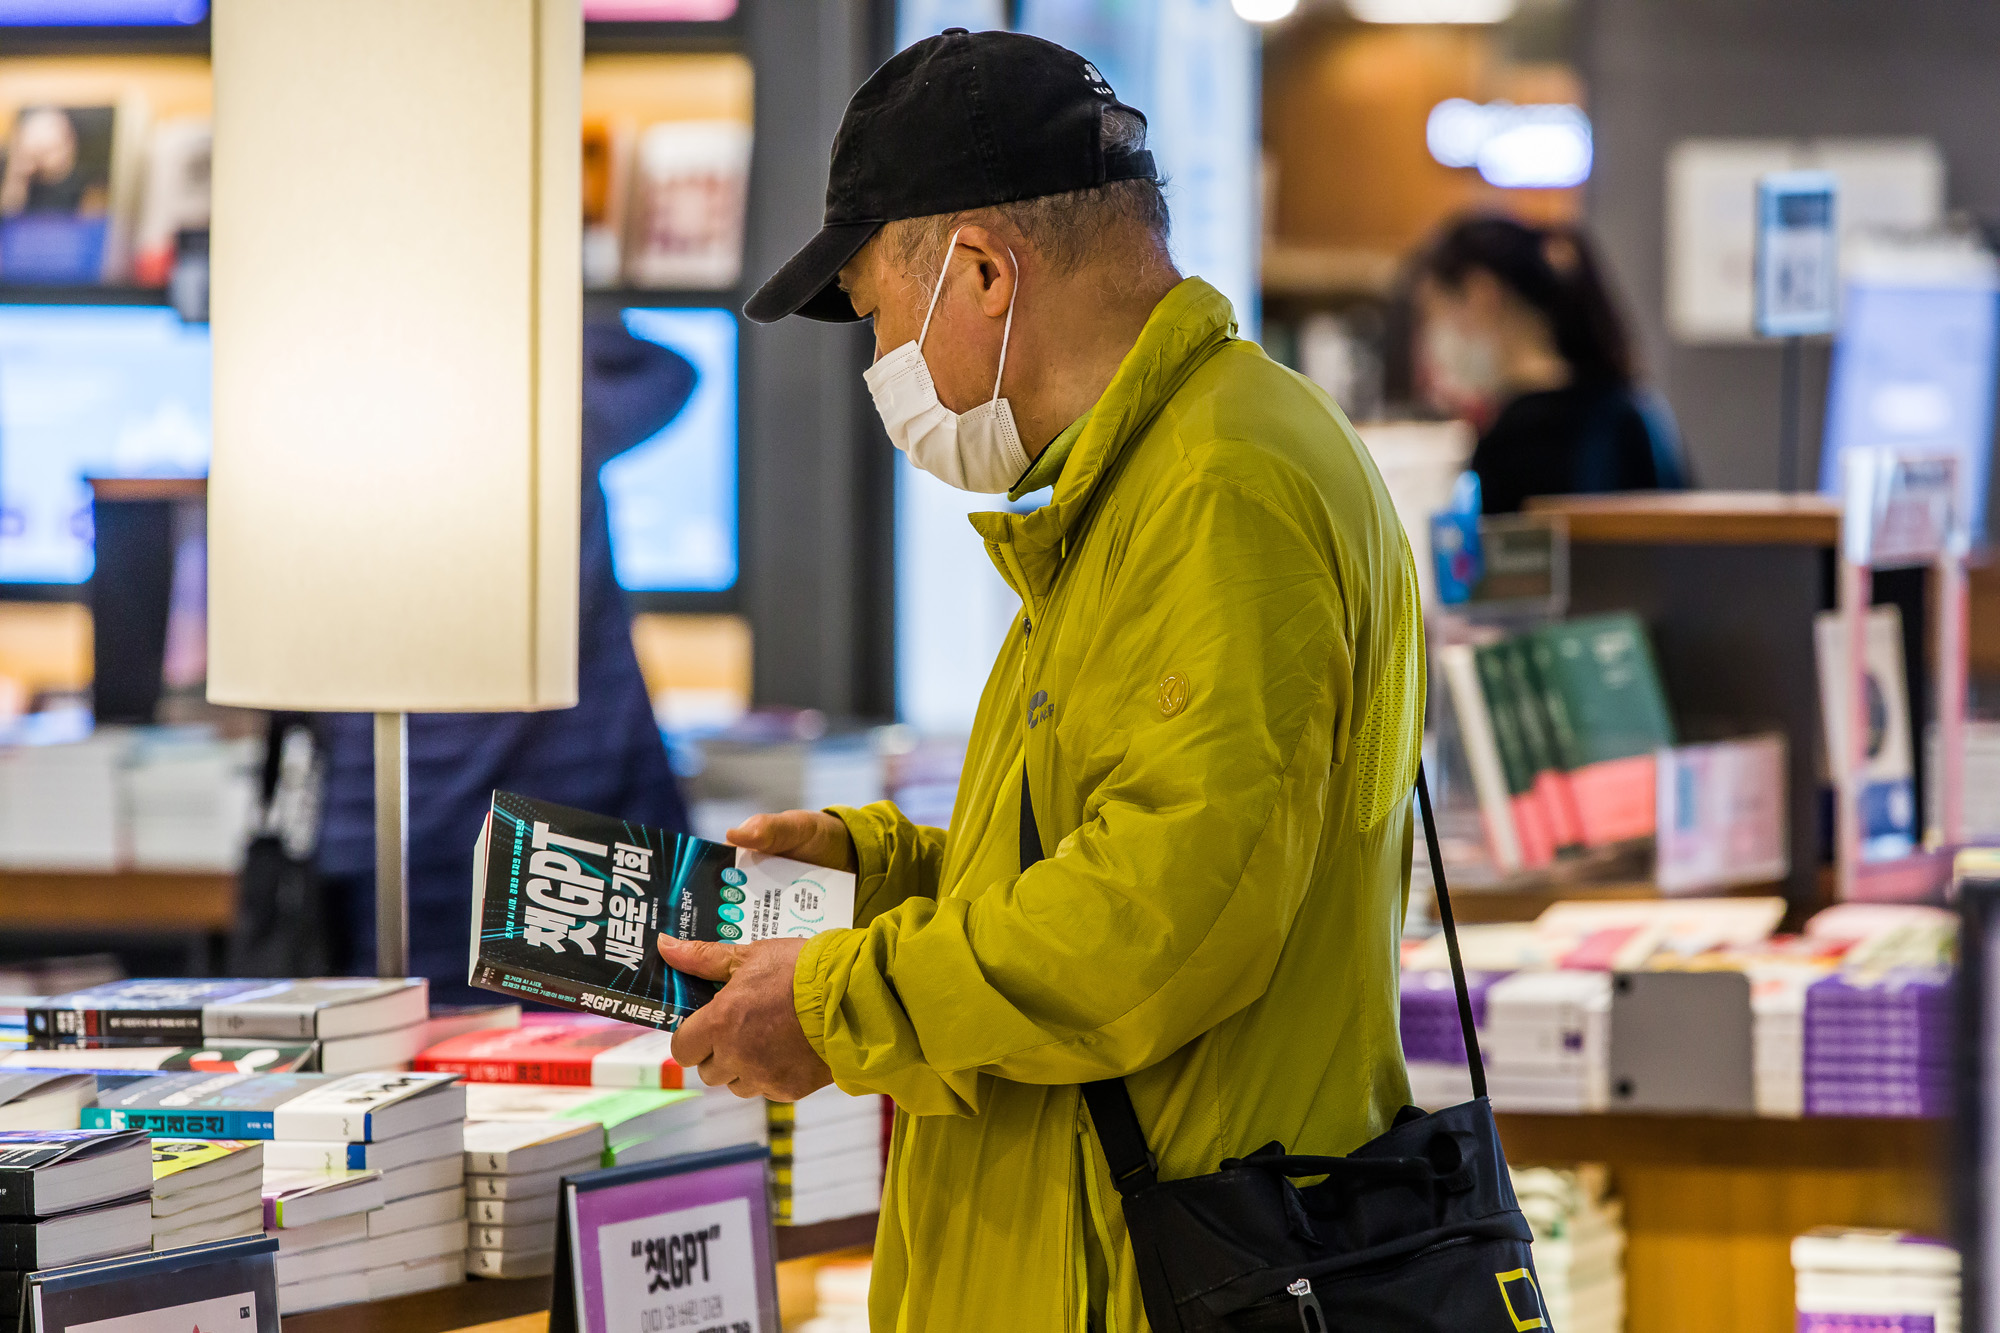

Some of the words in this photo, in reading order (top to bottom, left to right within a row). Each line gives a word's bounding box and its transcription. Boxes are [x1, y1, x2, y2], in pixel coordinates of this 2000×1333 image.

[511, 858, 521, 876] 투자의
[611, 841, 653, 898] 기회
[523, 820, 608, 956] 챗GPT
[504, 920, 515, 939] 초거대
[507, 911, 515, 920] AI
[604, 895, 648, 972] 새로운
[503, 974, 522, 984] 초거대
[523, 978, 530, 986] AI
[580, 992, 622, 1014] 챗GPT
[621, 1002, 666, 1025] 새로운
[667, 1013, 685, 1029] 기
